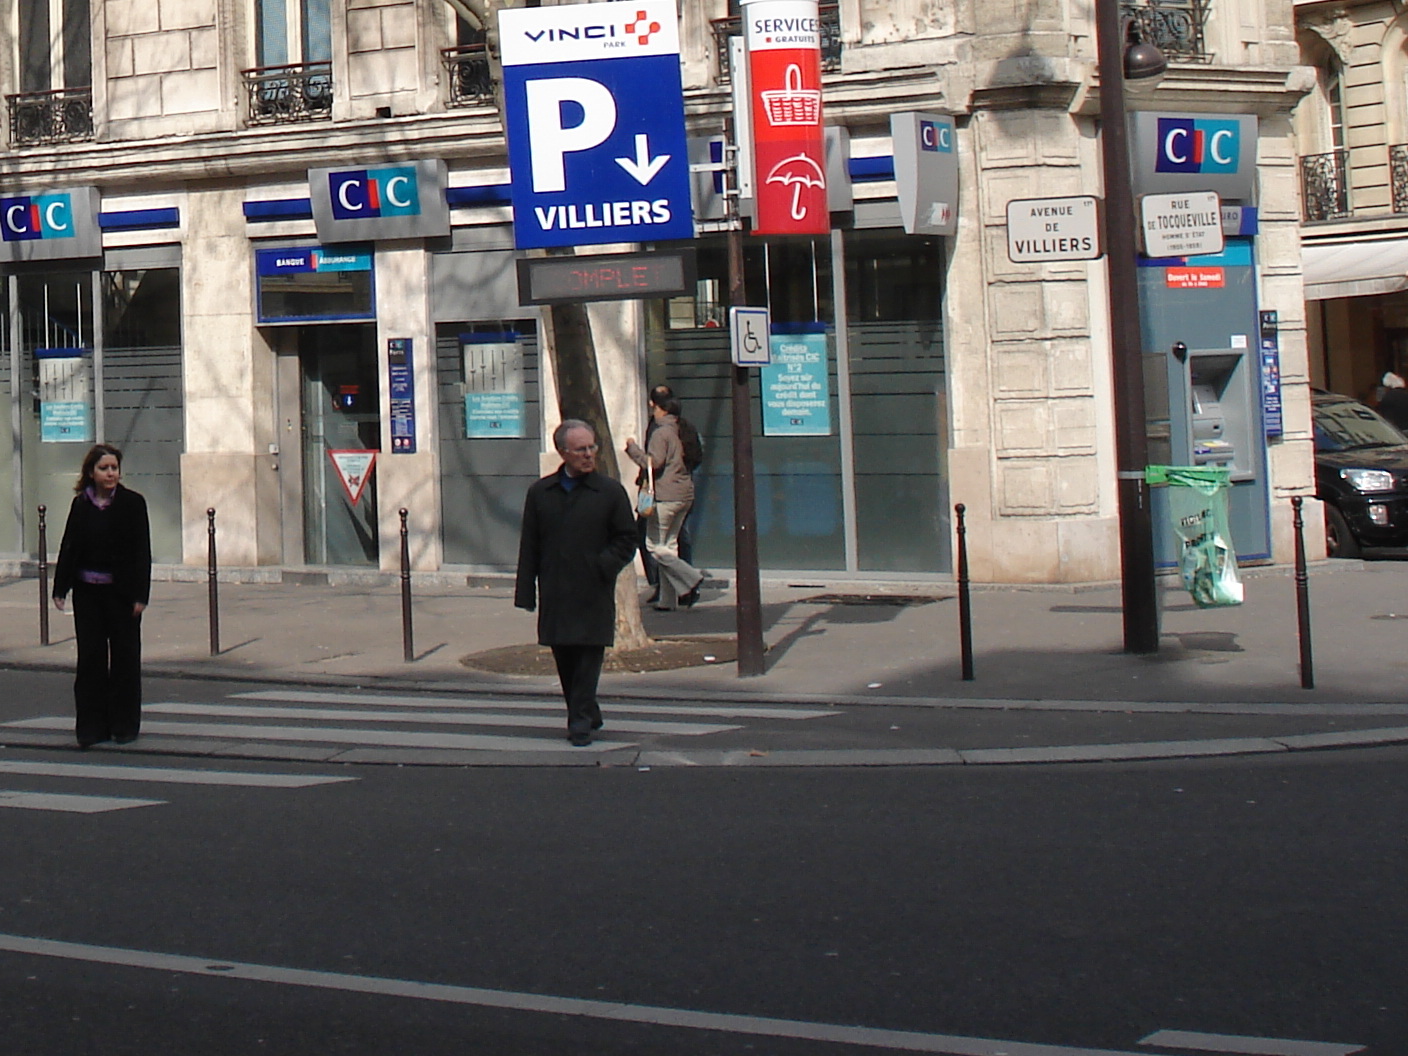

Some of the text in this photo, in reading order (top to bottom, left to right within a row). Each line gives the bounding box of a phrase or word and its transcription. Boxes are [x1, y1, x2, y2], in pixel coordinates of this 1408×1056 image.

[524, 24, 615, 42] VINCI
[755, 18, 819, 34] SERVICES
[775, 35, 815, 43] GRATUITS
[526, 77, 617, 193] P
[923, 126, 949, 148] CIC
[1165, 128, 1232, 164] CIC
[338, 176, 411, 211] CIC
[1030, 206, 1073, 217] AVENUE
[1171, 200, 1190, 210] RUE
[6, 202, 67, 233] CIC
[534, 199, 671, 230] VILLIERS
[1148, 212, 1217, 230] DE TOCQUEVILLE
[1045, 223, 1059, 233] DE
[1015, 237, 1092, 254] VILLIERS
